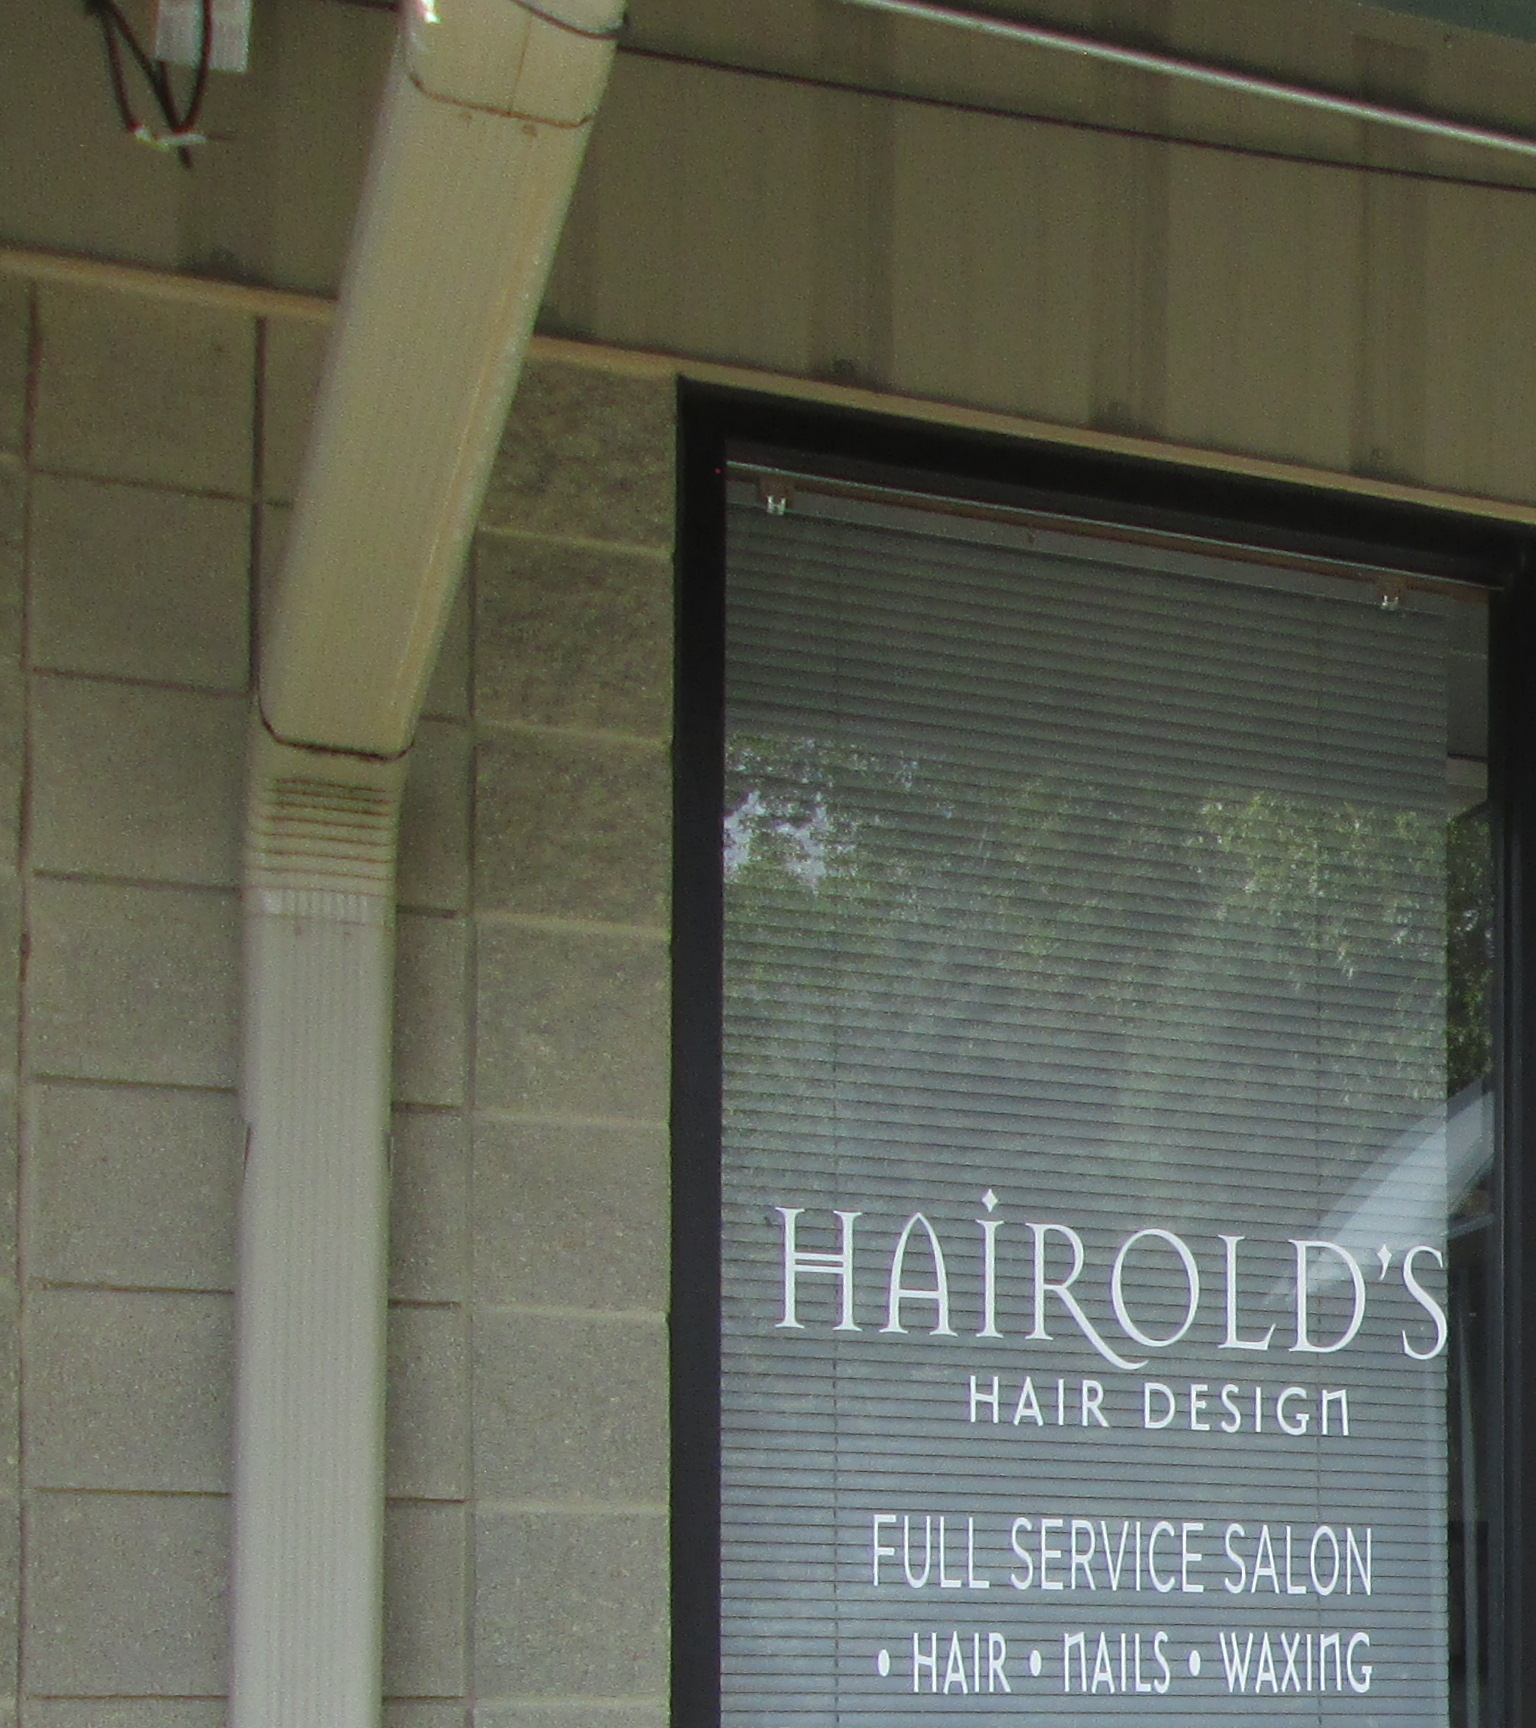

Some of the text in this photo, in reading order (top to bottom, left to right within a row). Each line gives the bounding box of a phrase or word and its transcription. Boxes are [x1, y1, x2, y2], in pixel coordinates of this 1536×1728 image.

[969, 1375, 1110, 1429] HAIR
[873, 1514, 1373, 1596] FULL SERVICE SALON
[913, 1631, 1011, 1694] HAIR
